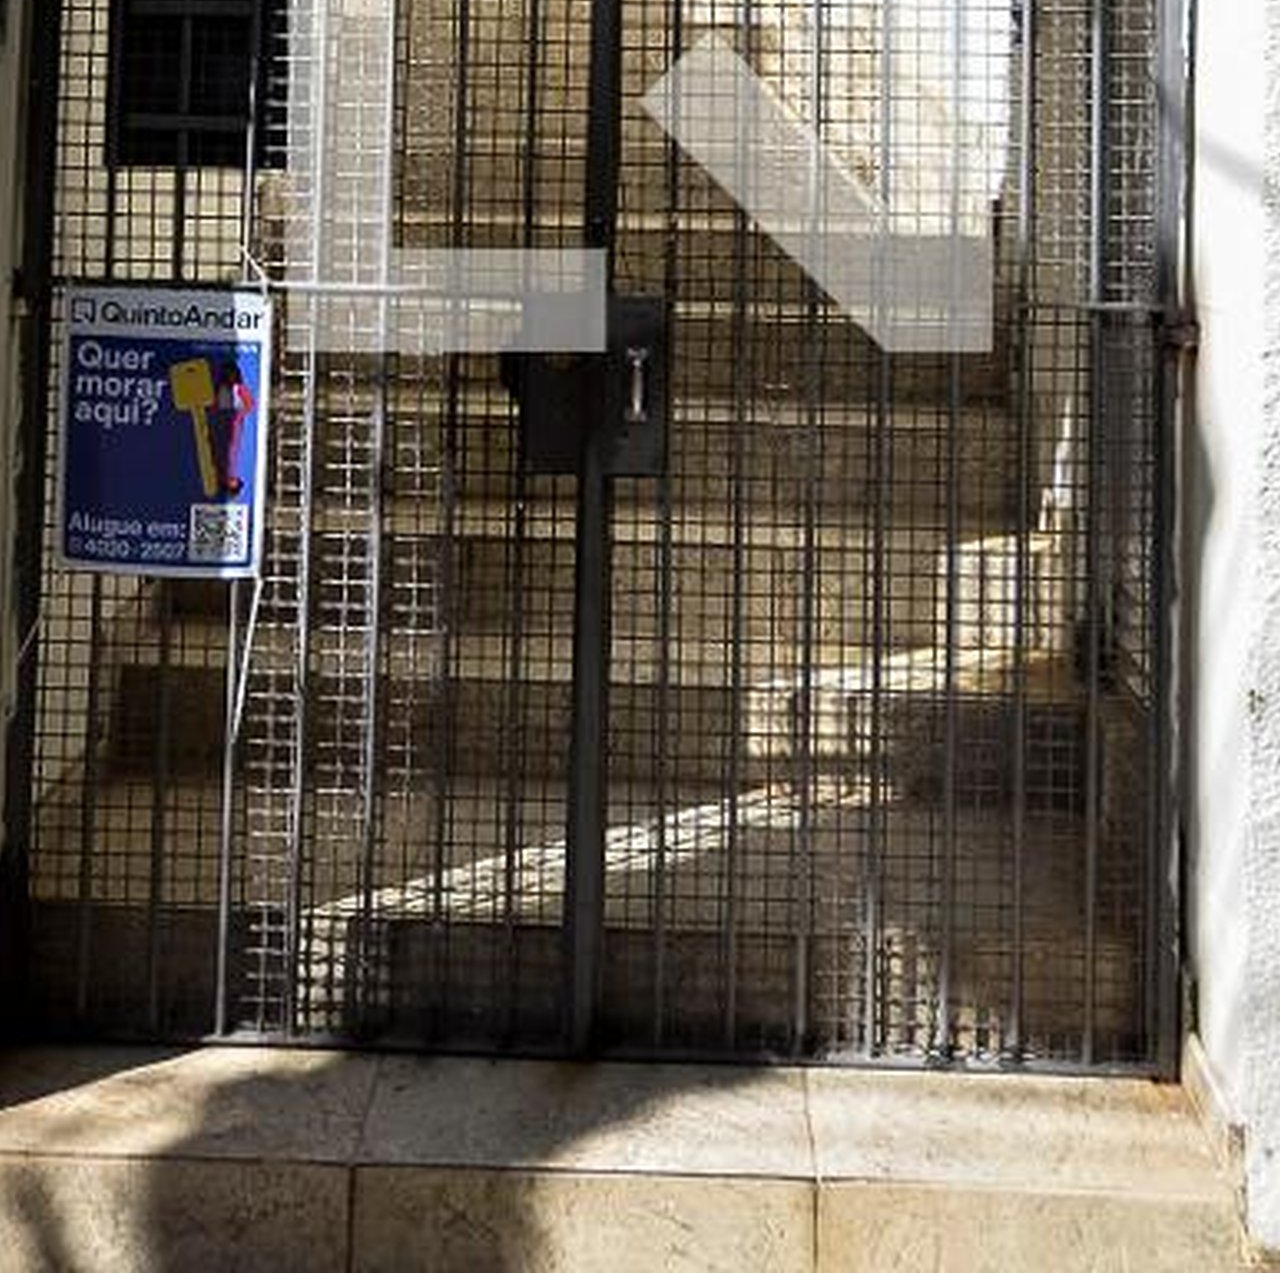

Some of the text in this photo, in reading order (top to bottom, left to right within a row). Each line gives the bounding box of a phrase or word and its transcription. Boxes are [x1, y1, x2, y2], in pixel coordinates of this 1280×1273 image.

[101, 301, 264, 329] QuintoAndar
[77, 339, 156, 370] Quer
[75, 375, 168, 399] morar
[74, 398, 159, 428] aqui?
[68, 510, 186, 539] Alugue em:
